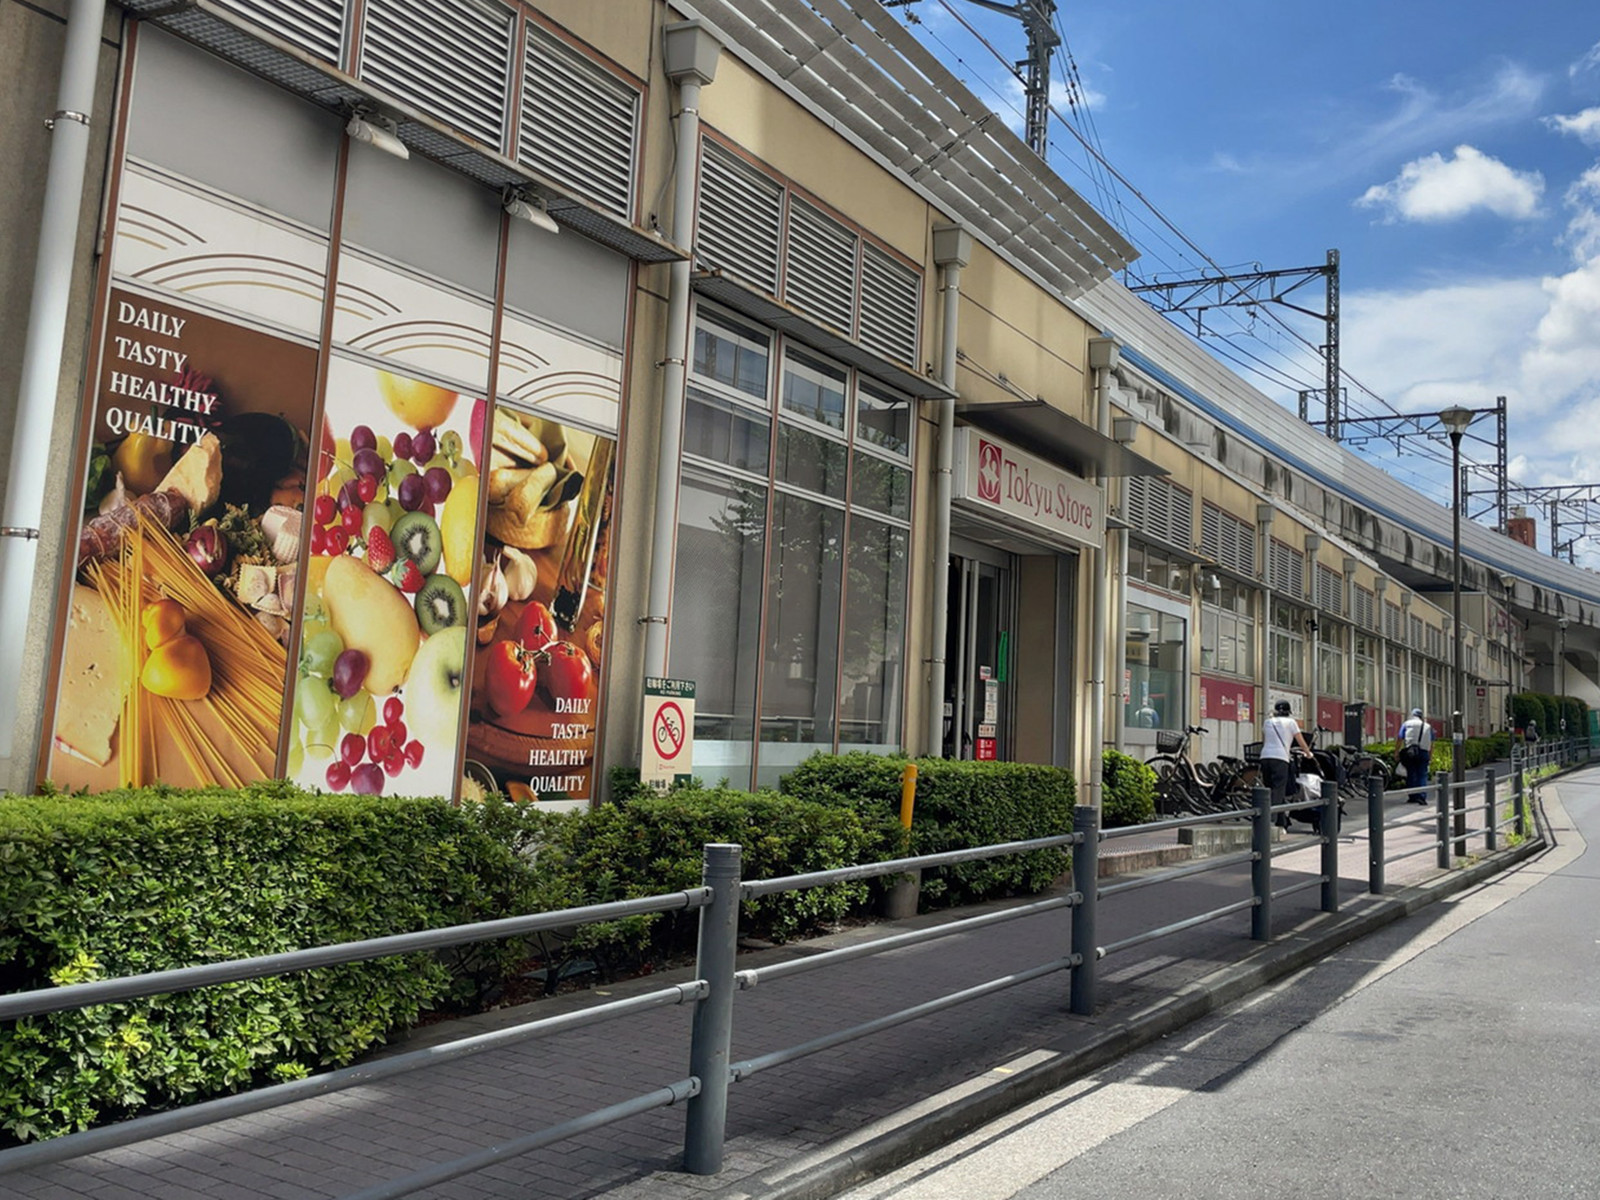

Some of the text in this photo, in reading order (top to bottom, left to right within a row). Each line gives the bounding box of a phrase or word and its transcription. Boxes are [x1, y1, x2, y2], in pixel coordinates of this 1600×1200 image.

[117, 301, 186, 339] DAILY
[115, 336, 188, 374] TASTY
[109, 371, 217, 415] HEALTHY
[105, 407, 208, 446] QUALITY
[1004, 459, 1093, 530] Tokyu Store
[555, 697, 591, 714] DAILY
[551, 723, 589, 740] TASTY
[529, 750, 587, 766] HEALTHY
[530, 776, 586, 795] QUALITY
